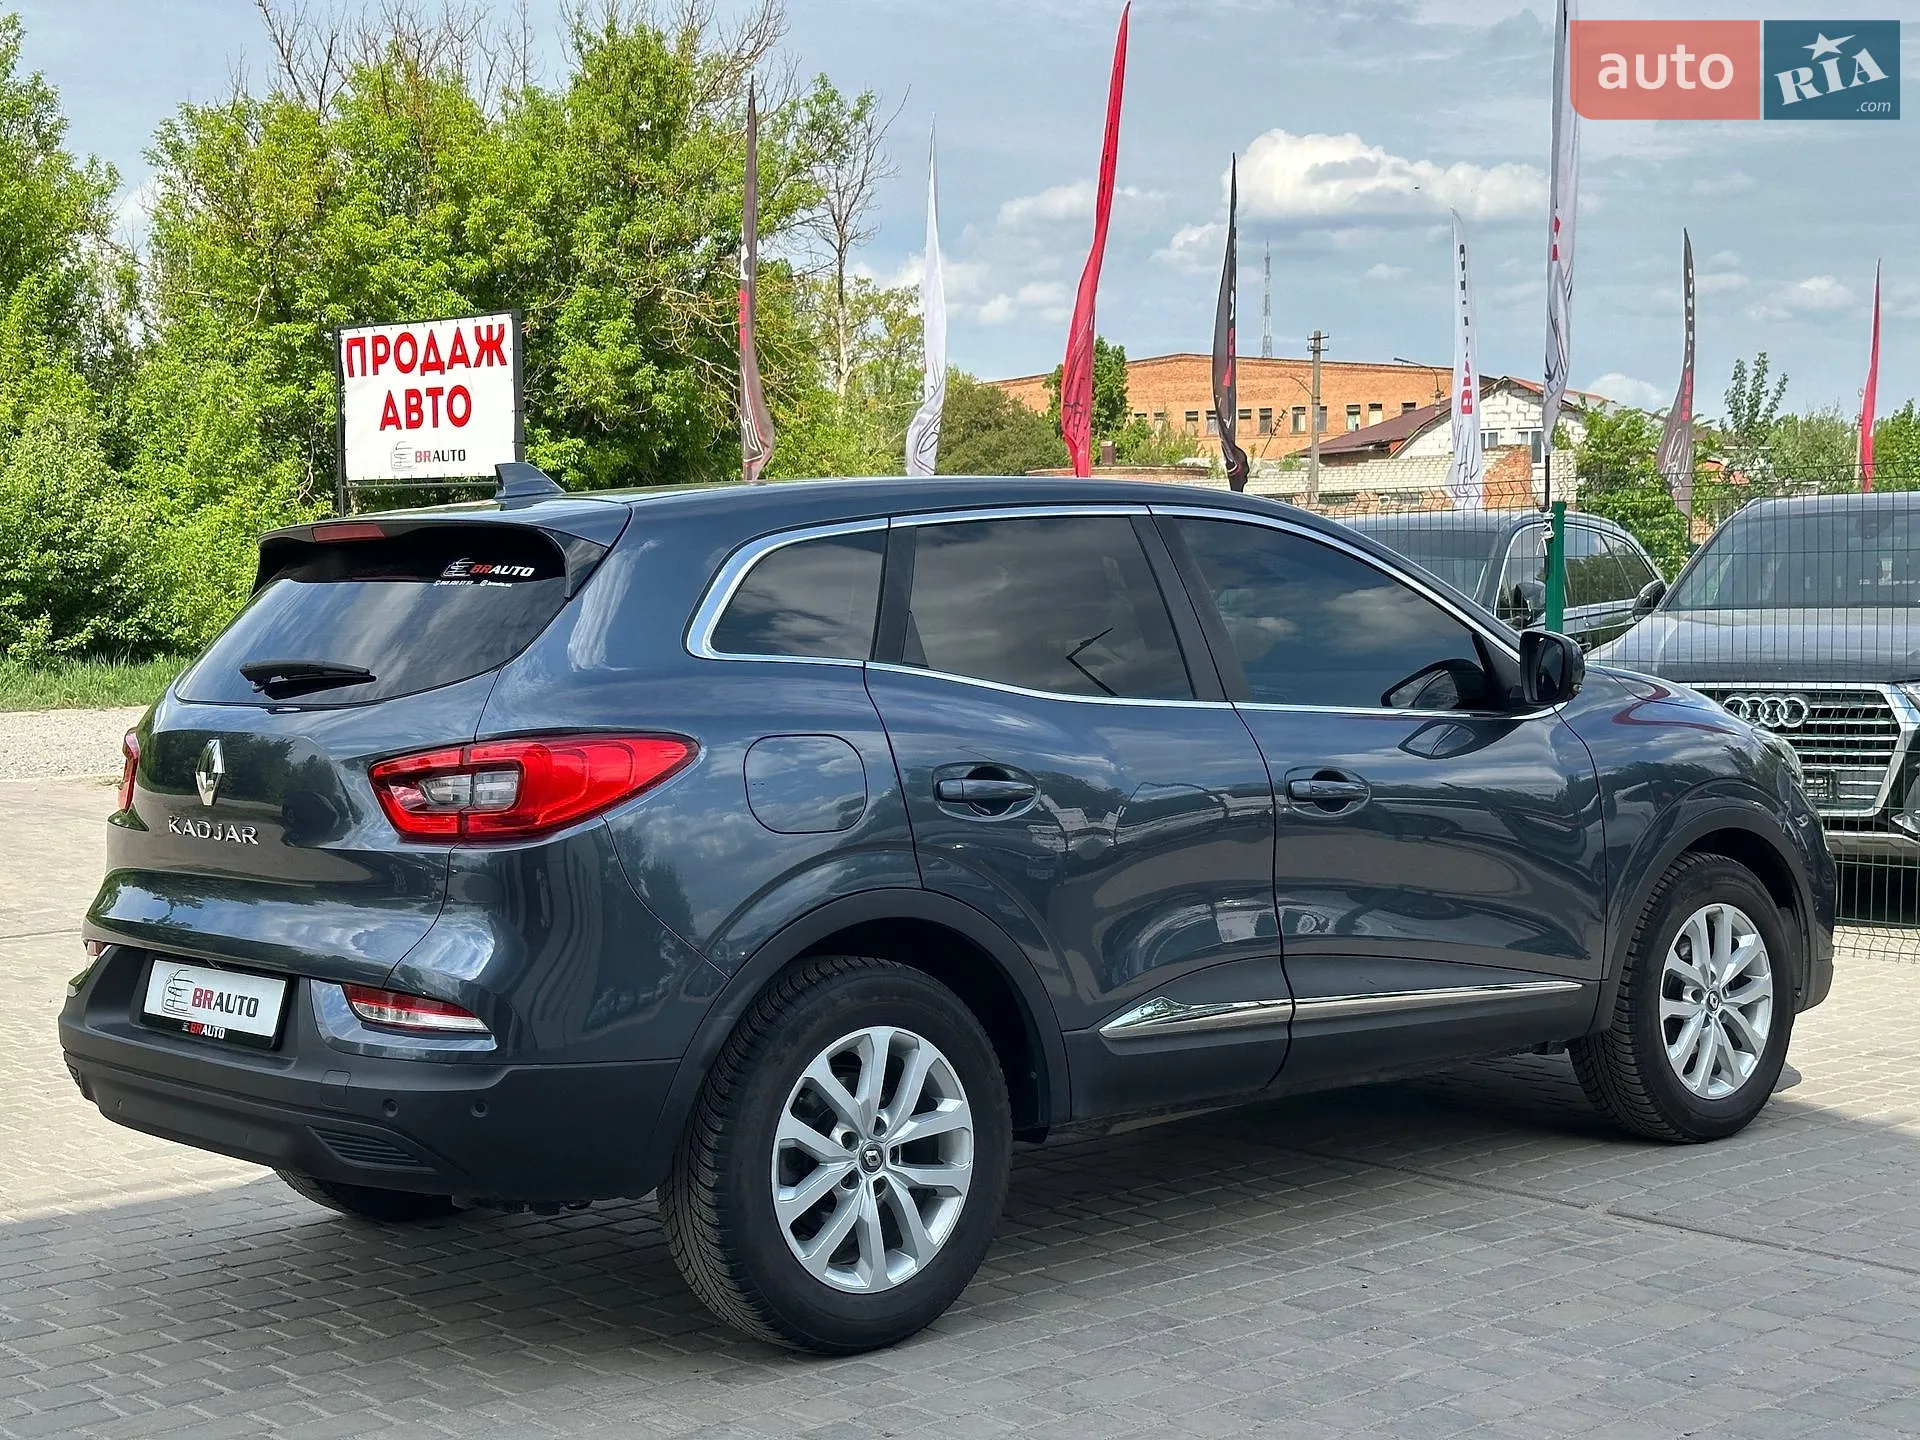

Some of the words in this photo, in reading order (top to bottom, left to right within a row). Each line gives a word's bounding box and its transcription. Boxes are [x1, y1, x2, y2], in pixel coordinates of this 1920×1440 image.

[346, 323, 508, 378] ПРОДАЖ
[379, 384, 472, 431] АВТО
[414, 449, 466, 463] BRAUTO
[469, 564, 535, 577] BRAUTO
[167, 815, 259, 845] KADJAR
[191, 987, 260, 1018] BRAUTO
[189, 1021, 226, 1039] BRAUTO
